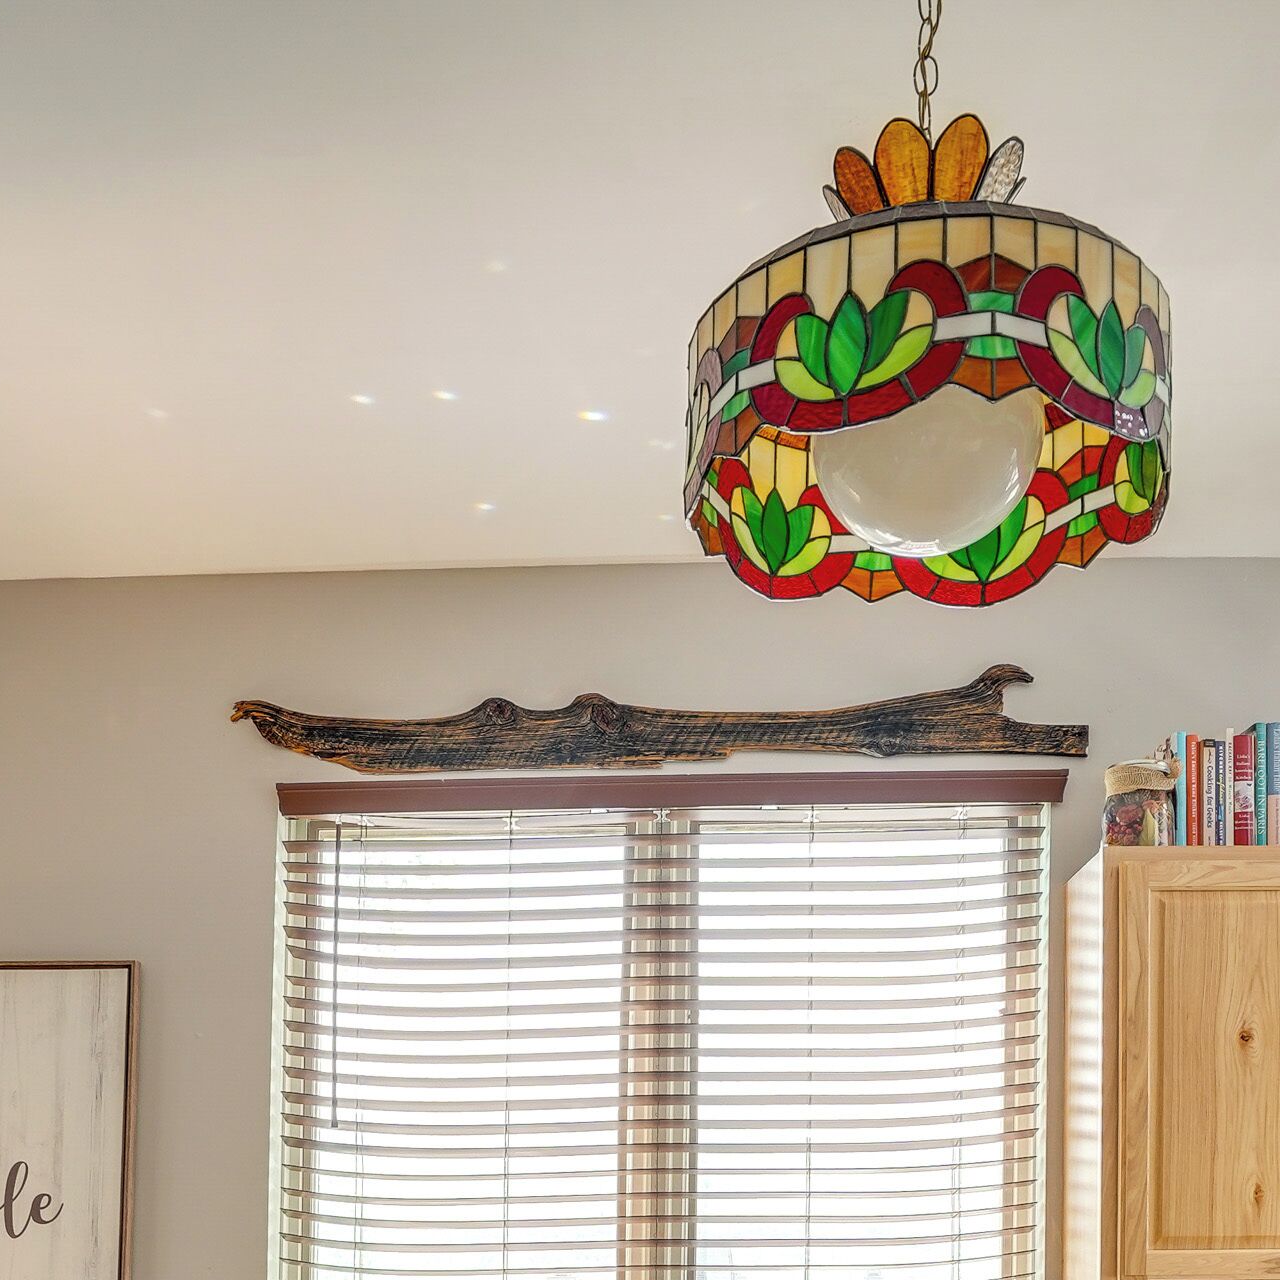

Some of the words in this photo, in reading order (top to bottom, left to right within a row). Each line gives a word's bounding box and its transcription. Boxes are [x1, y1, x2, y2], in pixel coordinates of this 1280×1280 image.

[1205, 765, 1214, 794] Cooking
[1258, 740, 1266, 793] BAREFOOT
[1258, 794, 1266, 806] IN
[1258, 808, 1266, 835] PARIS
